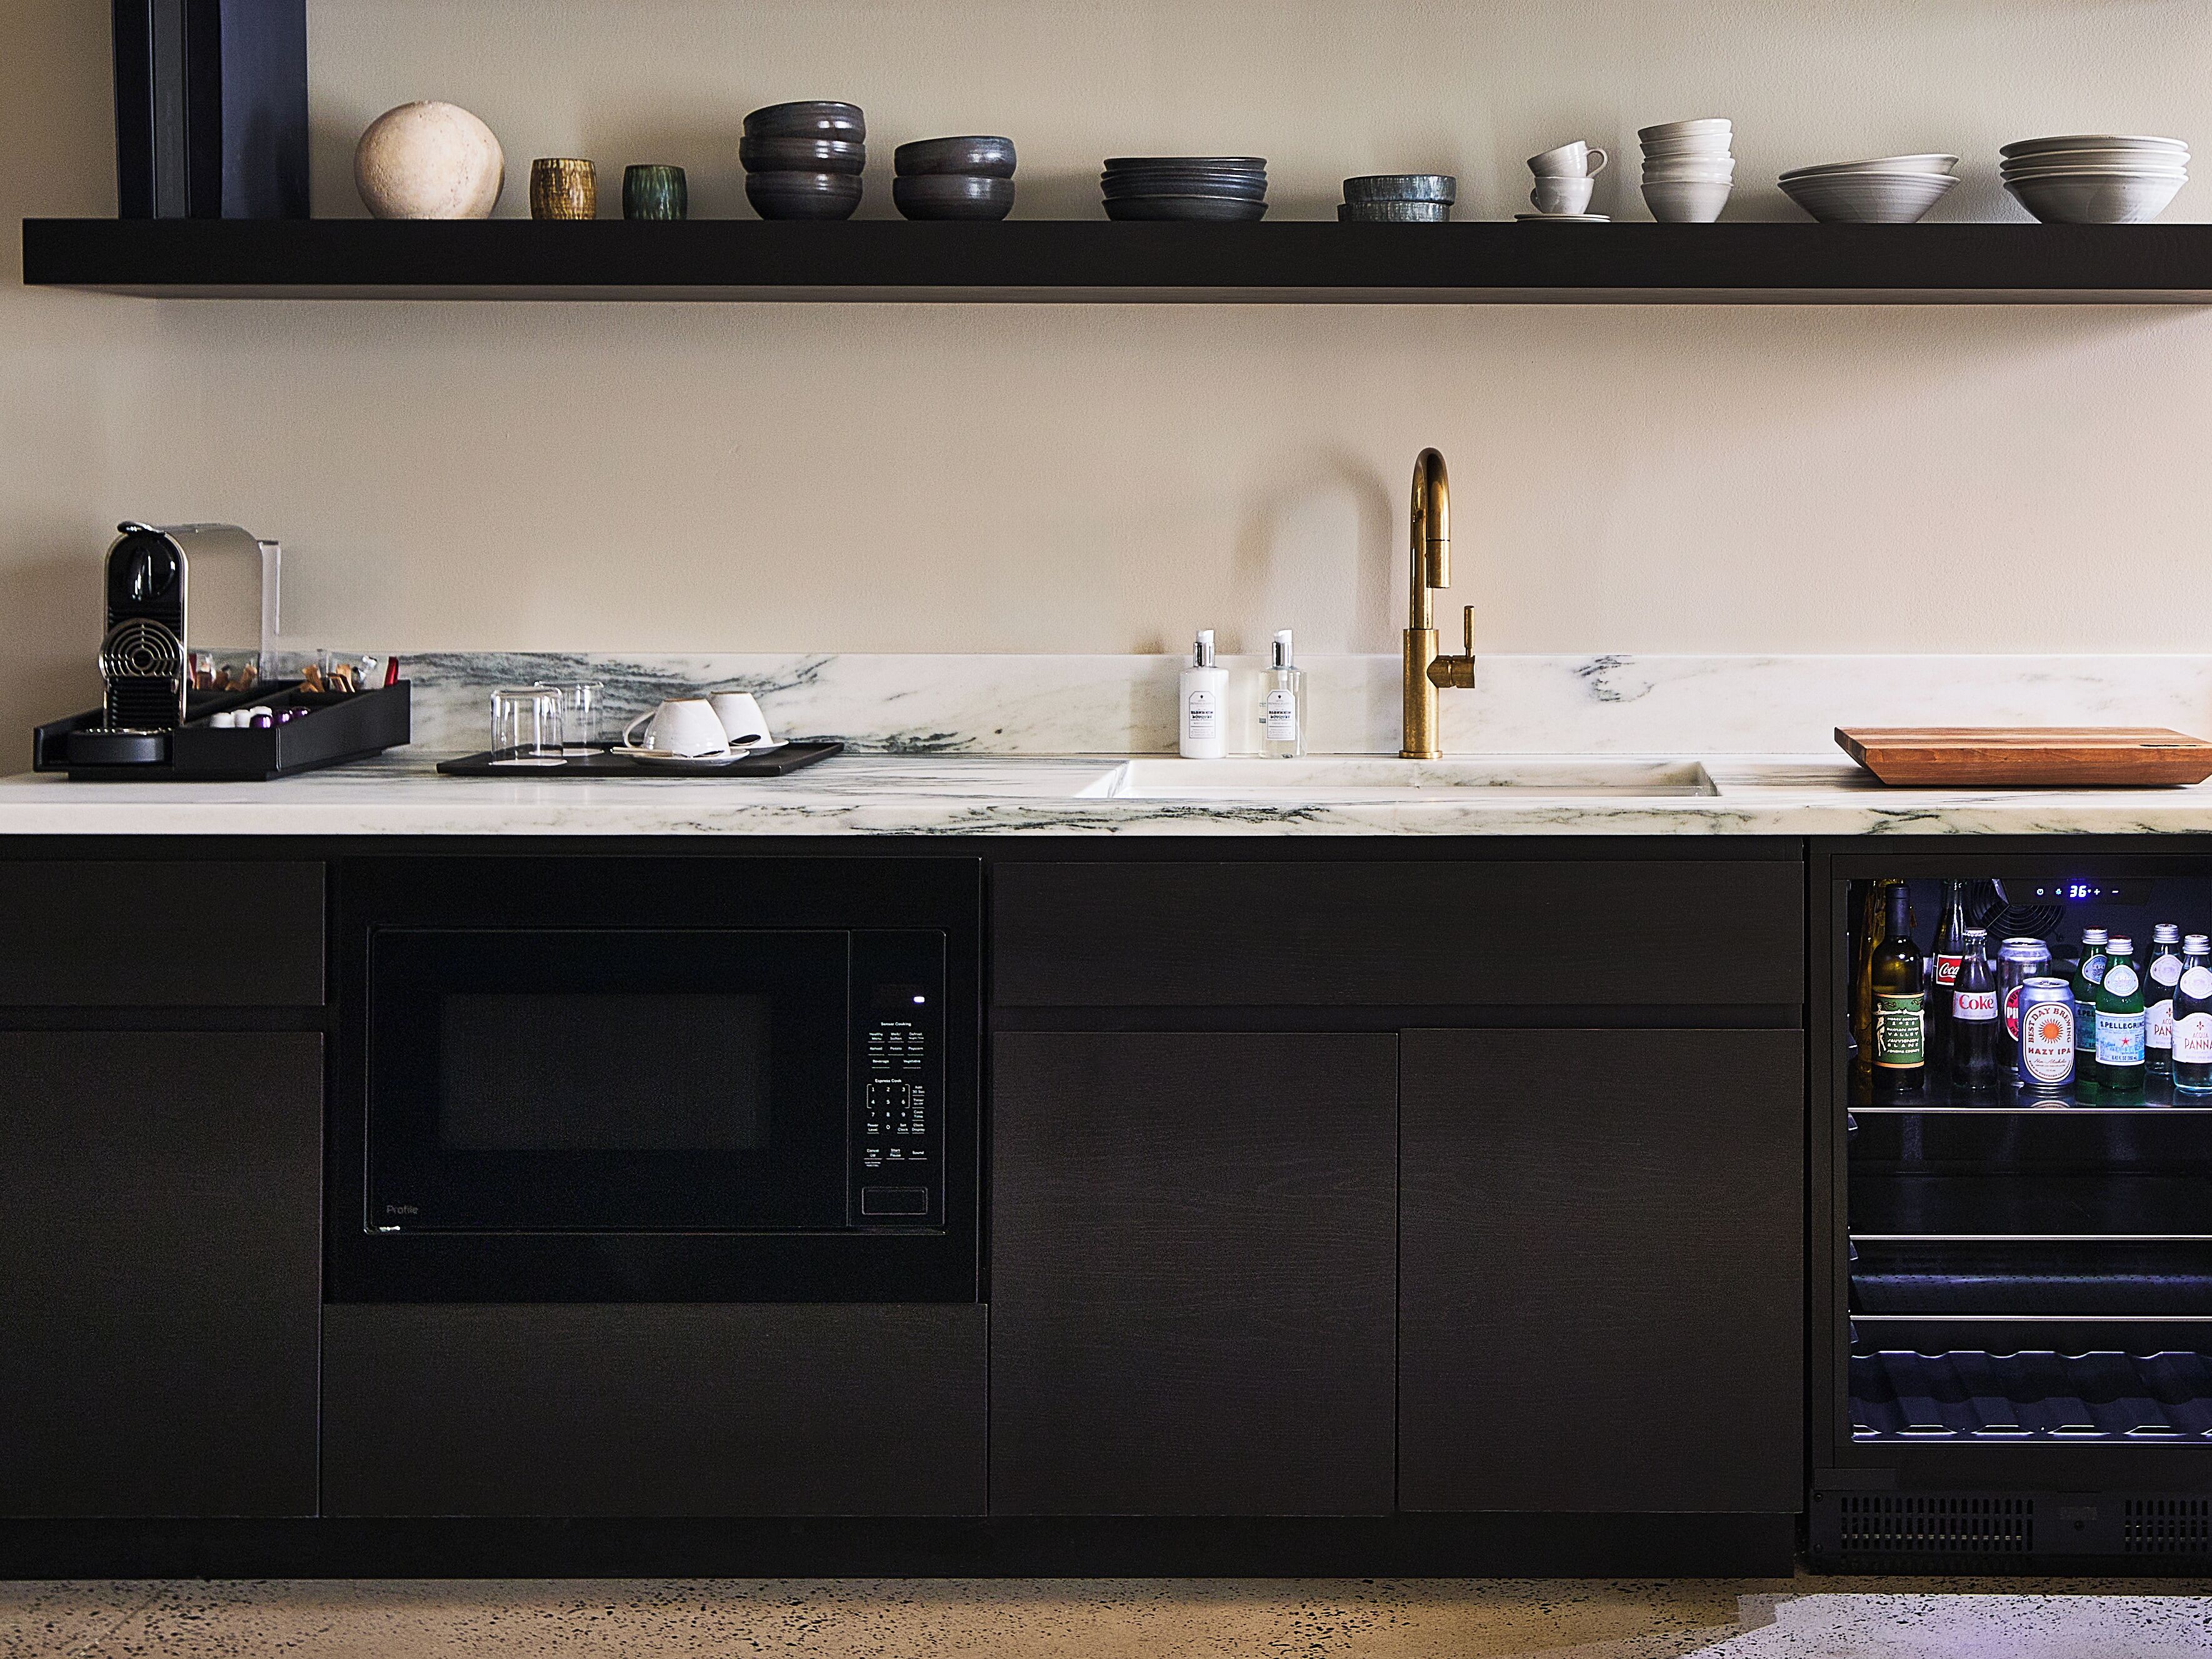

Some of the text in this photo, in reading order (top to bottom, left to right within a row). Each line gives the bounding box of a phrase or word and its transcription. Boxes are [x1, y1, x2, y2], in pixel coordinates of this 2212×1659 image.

[1959, 994, 1994, 1010] Coke
[2031, 1008, 2050, 1021] DAY
[2053, 1008, 2071, 1043] BREWING
